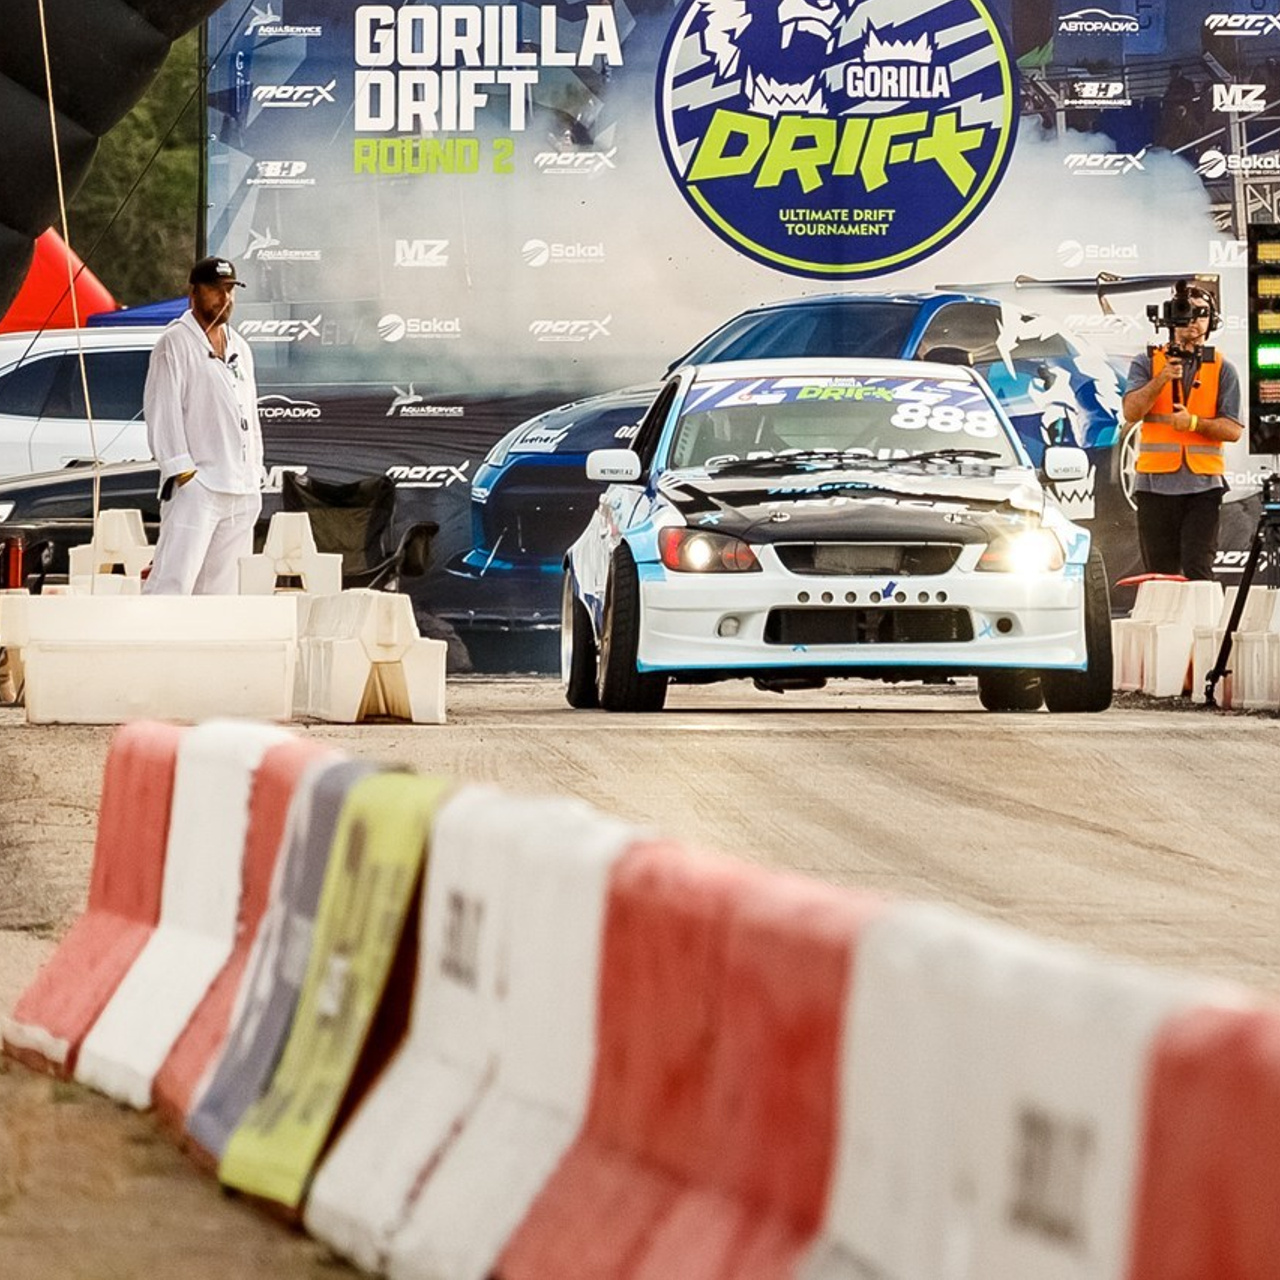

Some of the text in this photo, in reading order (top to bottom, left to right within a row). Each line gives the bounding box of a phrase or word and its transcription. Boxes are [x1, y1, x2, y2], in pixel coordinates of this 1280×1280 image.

[354, 4, 624, 66] GORILLA
[846, 65, 951, 98] GORILLA
[354, 70, 539, 132] DRIFT
[353, 138, 515, 174] ROUND 2
[1227, 154, 1280, 169] Sokol
[779, 209, 896, 221] ULTIMATE DRIFT
[785, 223, 889, 236] TOURNAMENT
[551, 243, 605, 258] Sokol
[407, 317, 462, 332] Sokol
[258, 407, 322, 418] ТОРАДИО
[890, 402, 1000, 439] 888
